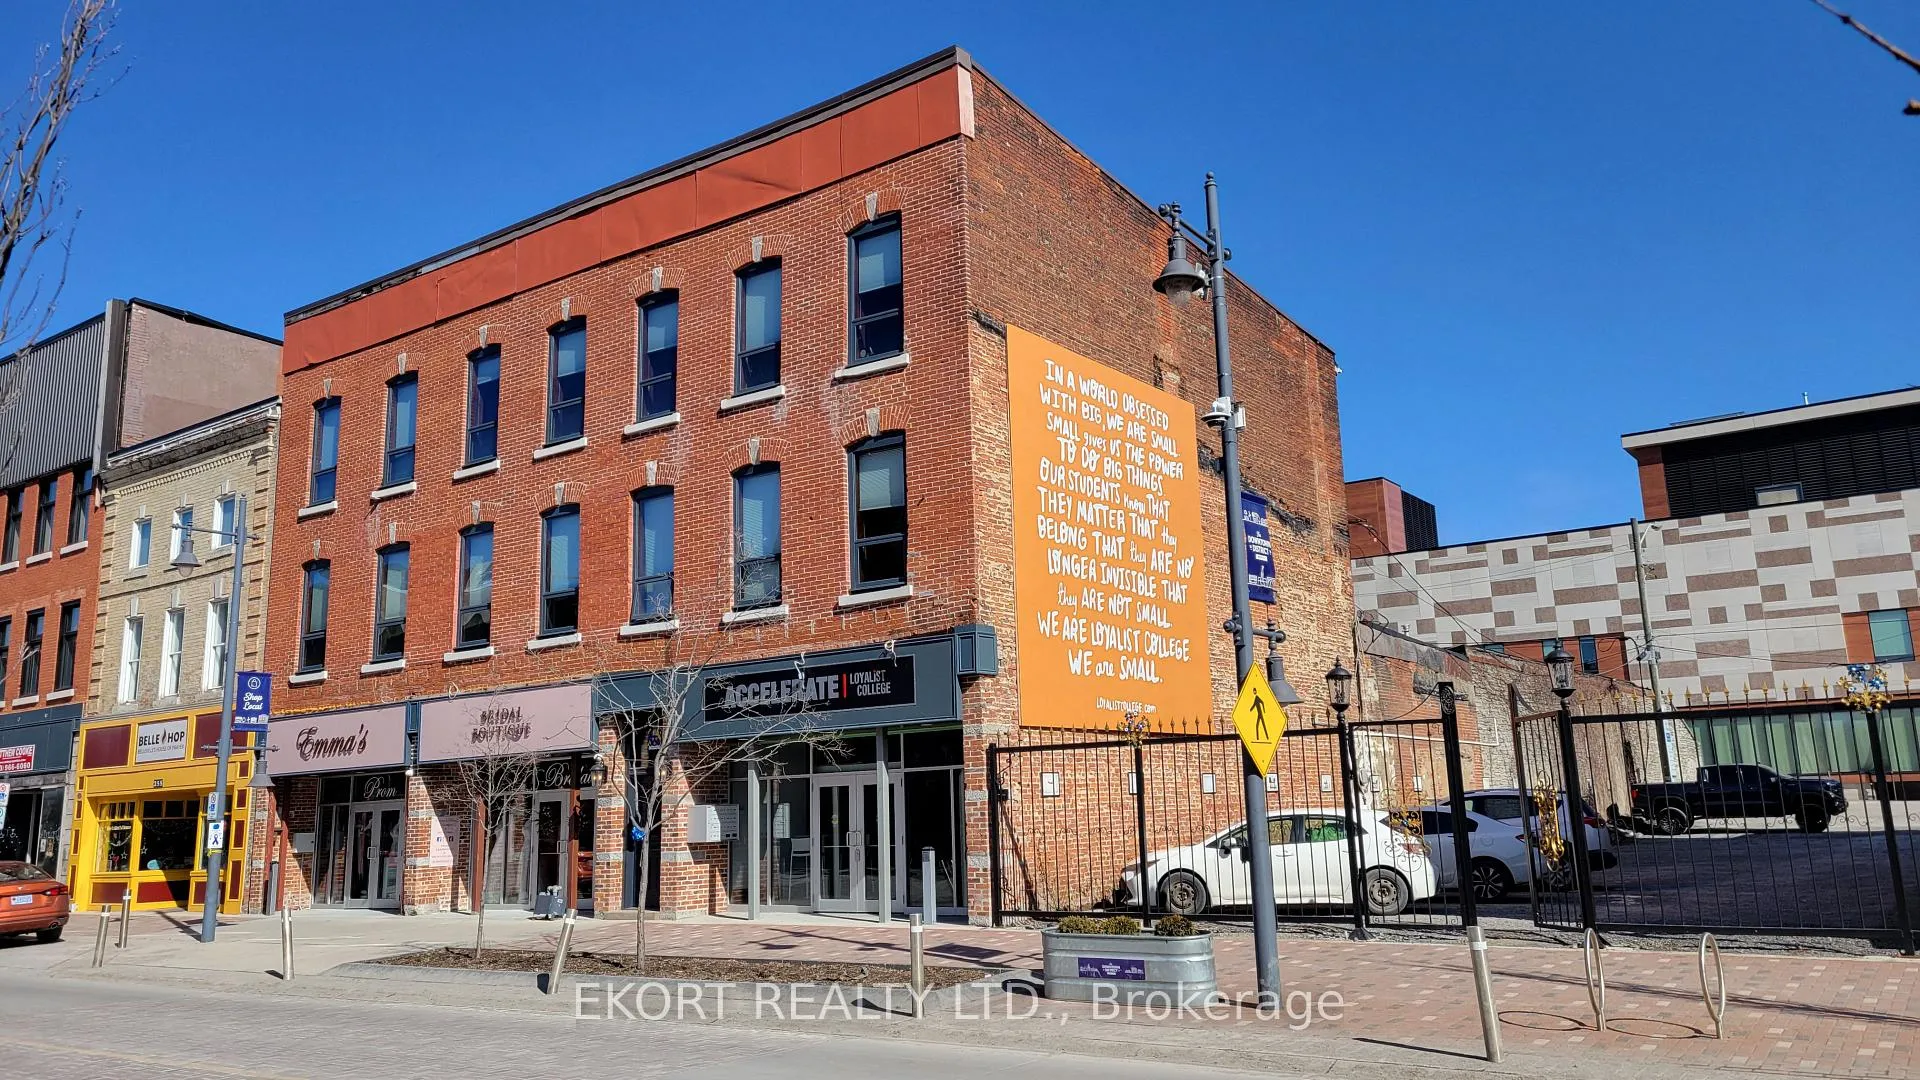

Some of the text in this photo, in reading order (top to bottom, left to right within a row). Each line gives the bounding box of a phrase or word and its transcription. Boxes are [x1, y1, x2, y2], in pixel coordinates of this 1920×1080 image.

[1039, 383, 1077, 415] WITH
[1107, 412, 1124, 431] WE
[1127, 421, 1147, 443] ARE
[1044, 359, 1169, 431] IN A WORLD OBSESSED
[1046, 412, 1184, 481] SMALL gives US THE POWER
[1057, 437, 1077, 464] TO
[1081, 446, 1100, 472] DO
[1103, 457, 1122, 480] BIG
[1039, 457, 1066, 489] OUR
[1068, 470, 1121, 504] STUDENTS
[1146, 494, 1171, 522] THAT
[1037, 485, 1178, 554] THEY MATTER THAT they
[1037, 514, 1195, 579] BELONG THAT they ARE NO
[1047, 548, 1097, 582] LONGER
[1161, 579, 1188, 605] THAT
[1057, 582, 1173, 629] they ARE NOT SMALL.
[1037, 610, 1060, 638] WE
[1062, 615, 1087, 644] ARE
[1090, 621, 1141, 653] LOYALIST
[1068, 648, 1163, 684] WE are SMALL.
[243, 692, 263, 703] Shop
[243, 702, 263, 710] Local
[724, 675, 840, 708] ACCELERATE
[857, 682, 891, 697] COLLEGE
[138, 731, 185, 746] BELLE HOP
[296, 723, 368, 761] Emma's
[363, 777, 397, 799] Prom
